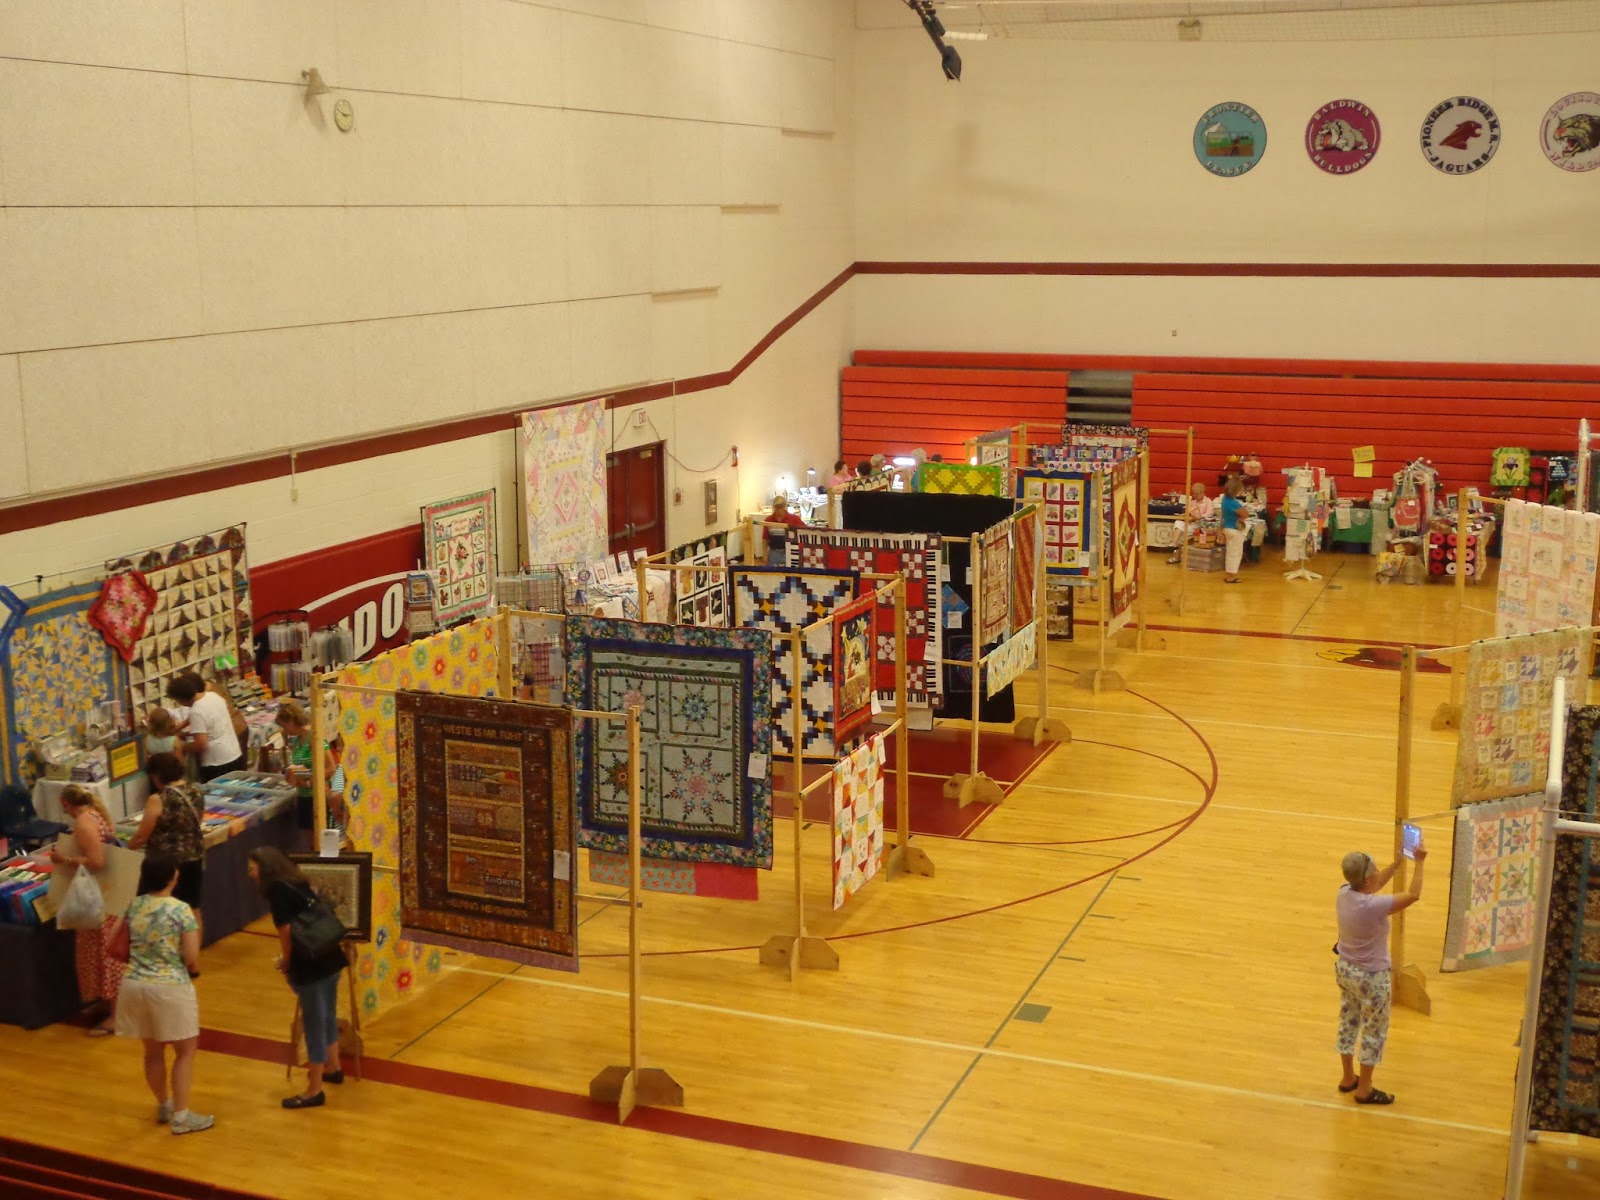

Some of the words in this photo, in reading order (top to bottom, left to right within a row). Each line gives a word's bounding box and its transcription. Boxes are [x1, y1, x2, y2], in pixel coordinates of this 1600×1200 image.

[1313, 101, 1371, 120] BALDWIN
[1422, 101, 1454, 148] PIONEER
[1457, 98, 1494, 121] RIDGE
[1313, 152, 1373, 173] BULLDOGS
[1429, 152, 1490, 173] JAGUARS
